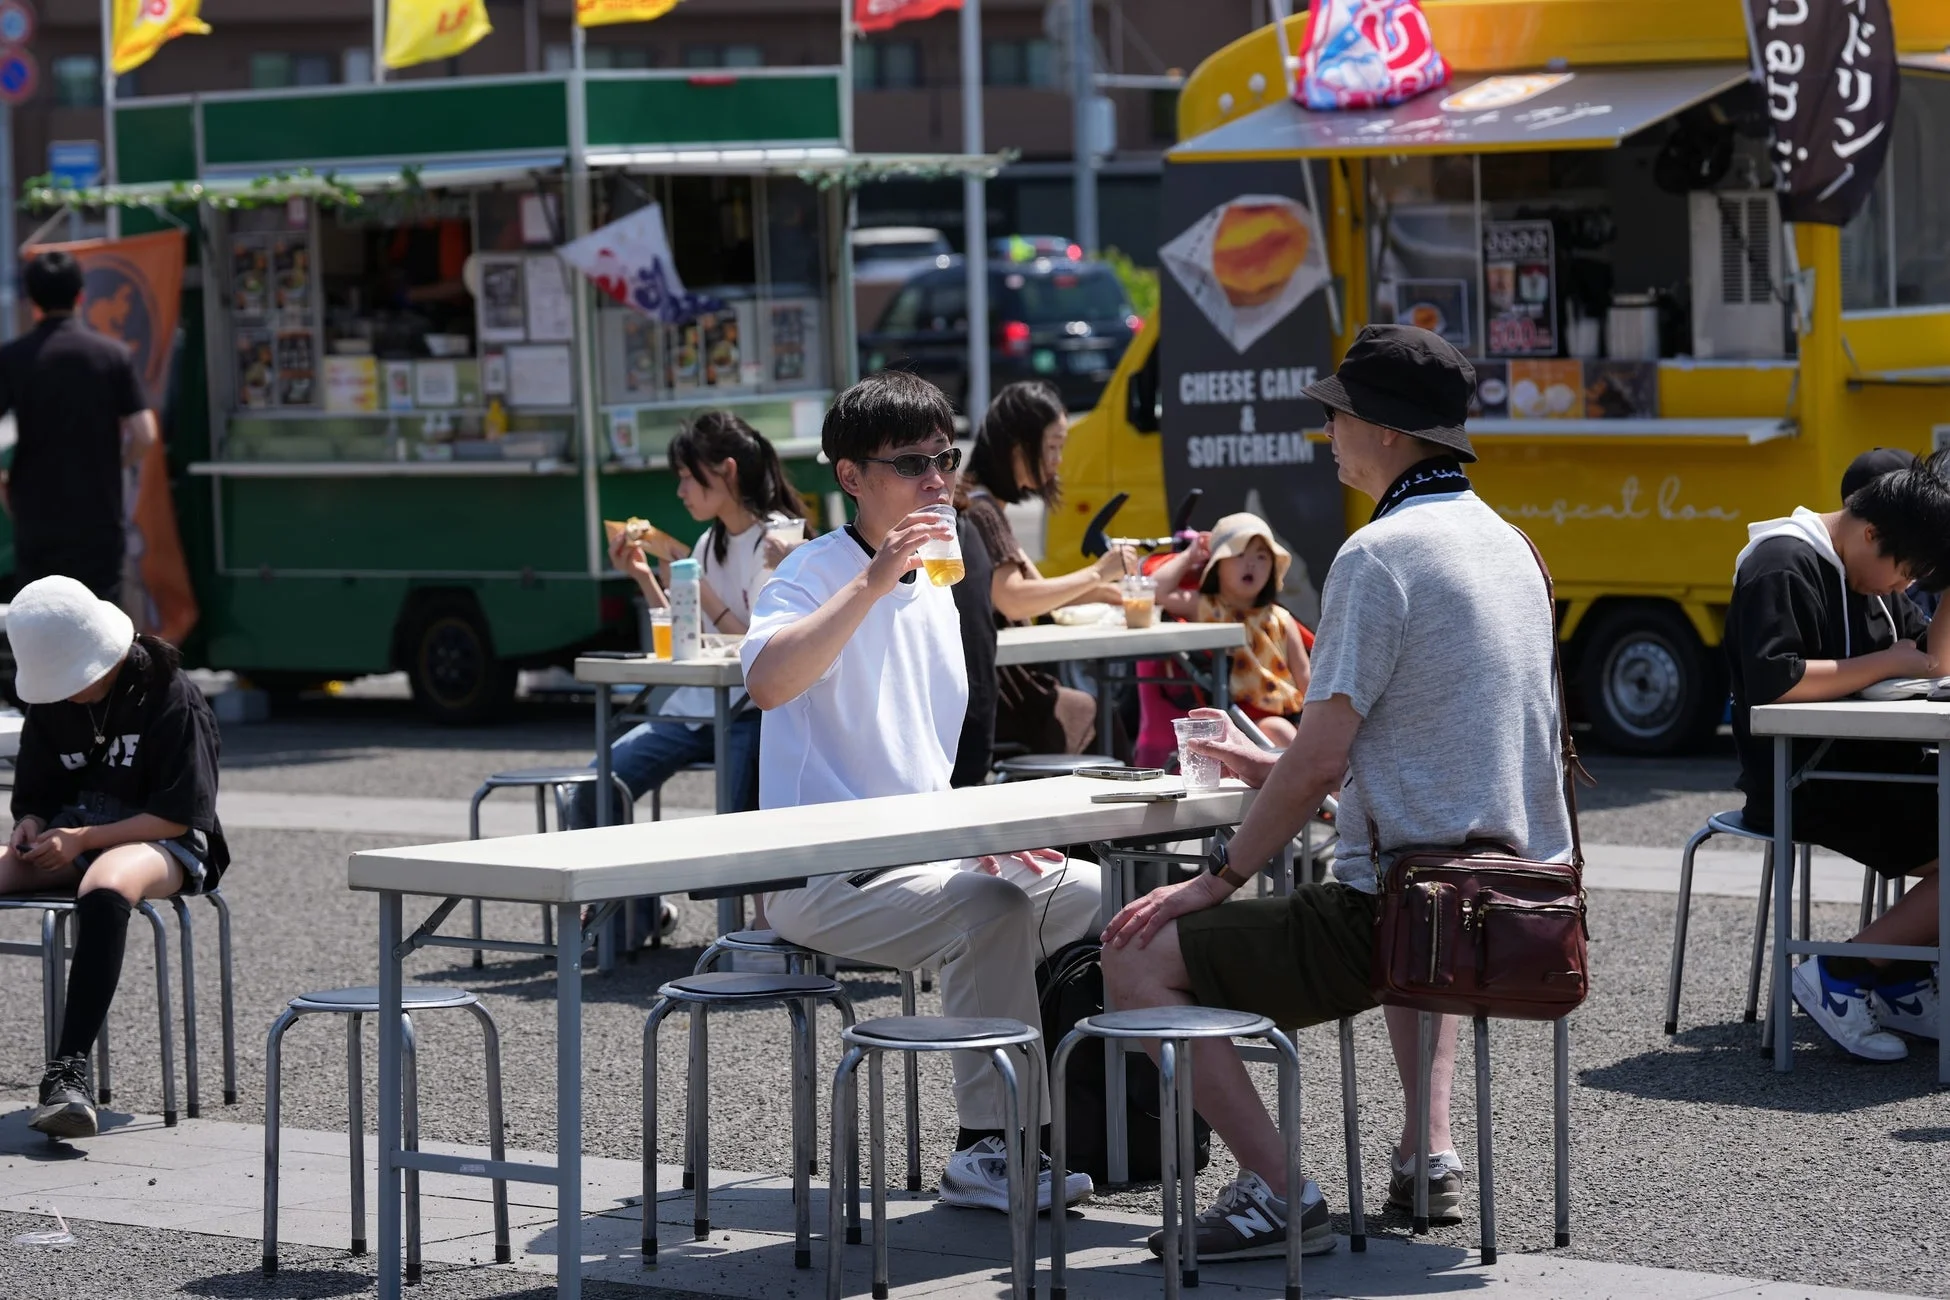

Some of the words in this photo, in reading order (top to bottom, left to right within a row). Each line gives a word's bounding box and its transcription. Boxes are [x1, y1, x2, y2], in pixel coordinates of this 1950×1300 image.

[1489, 318, 1537, 352] 500
[1180, 369, 1257, 404] CHEESE
[1260, 366, 1317, 400] CAKE
[1239, 405, 1256, 433] &
[1187, 430, 1315, 468] SOFTCREAM
[1225, 1206, 1275, 1239] N
